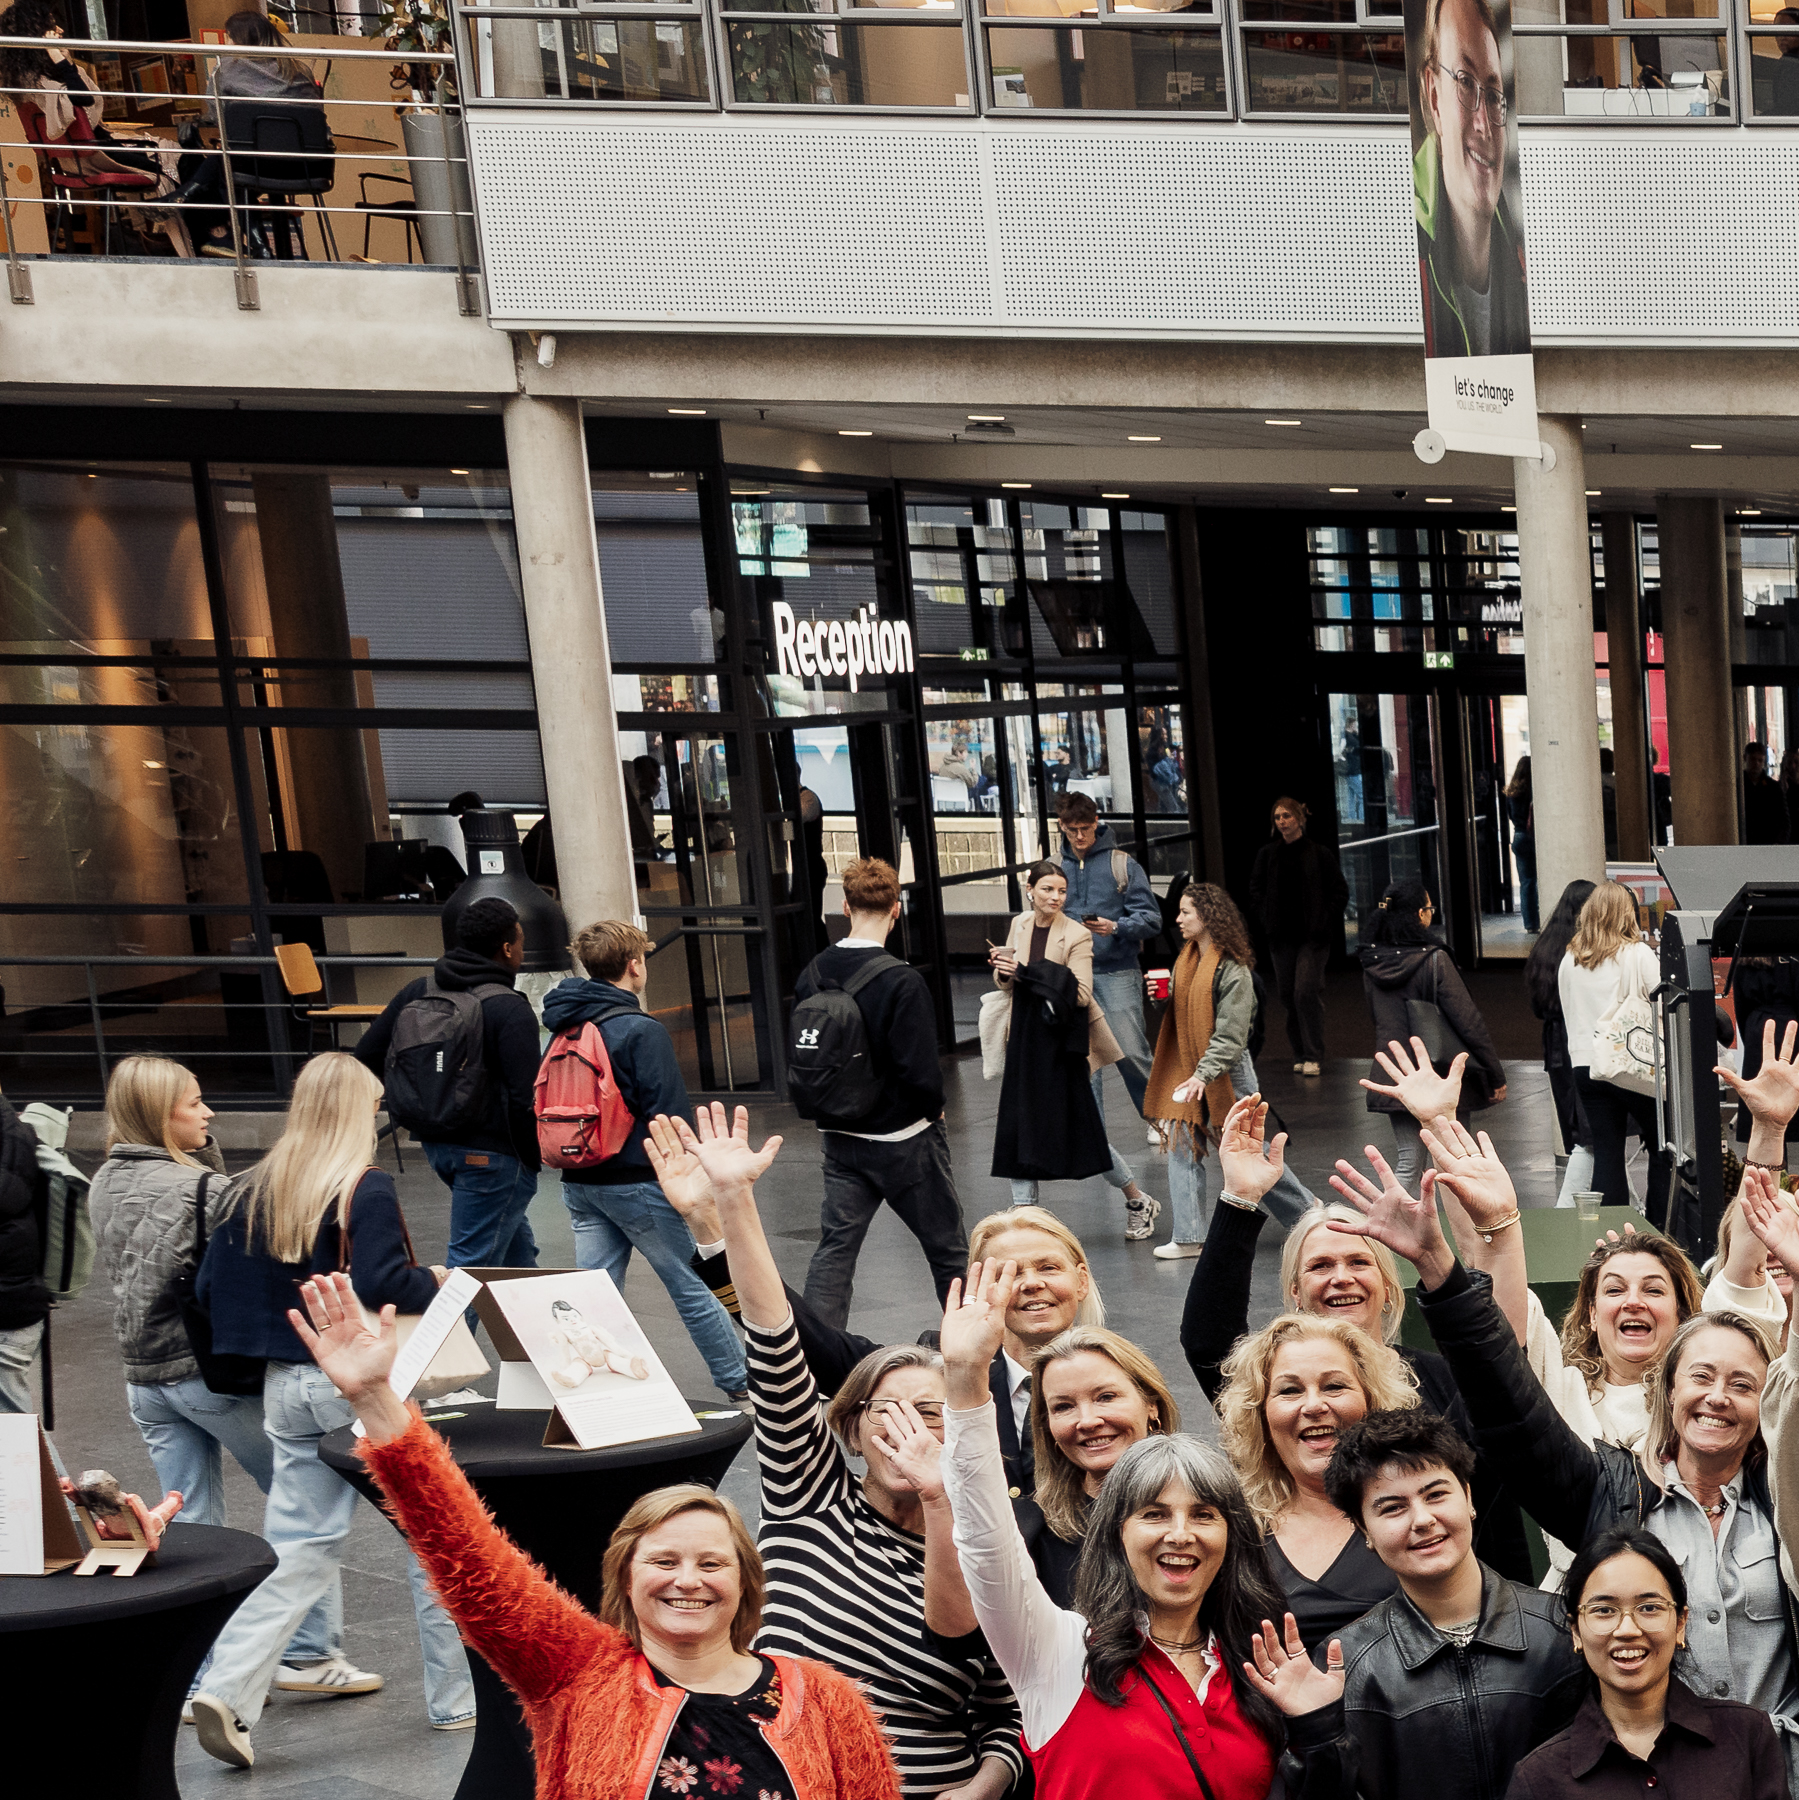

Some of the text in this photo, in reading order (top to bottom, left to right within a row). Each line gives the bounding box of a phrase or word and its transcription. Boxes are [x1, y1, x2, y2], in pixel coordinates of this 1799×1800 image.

[1454, 375, 1514, 406] let's change
[1476, 402, 1485, 412] THE
[772, 601, 914, 693] Reception
[436, 1050, 444, 1072] THULE
